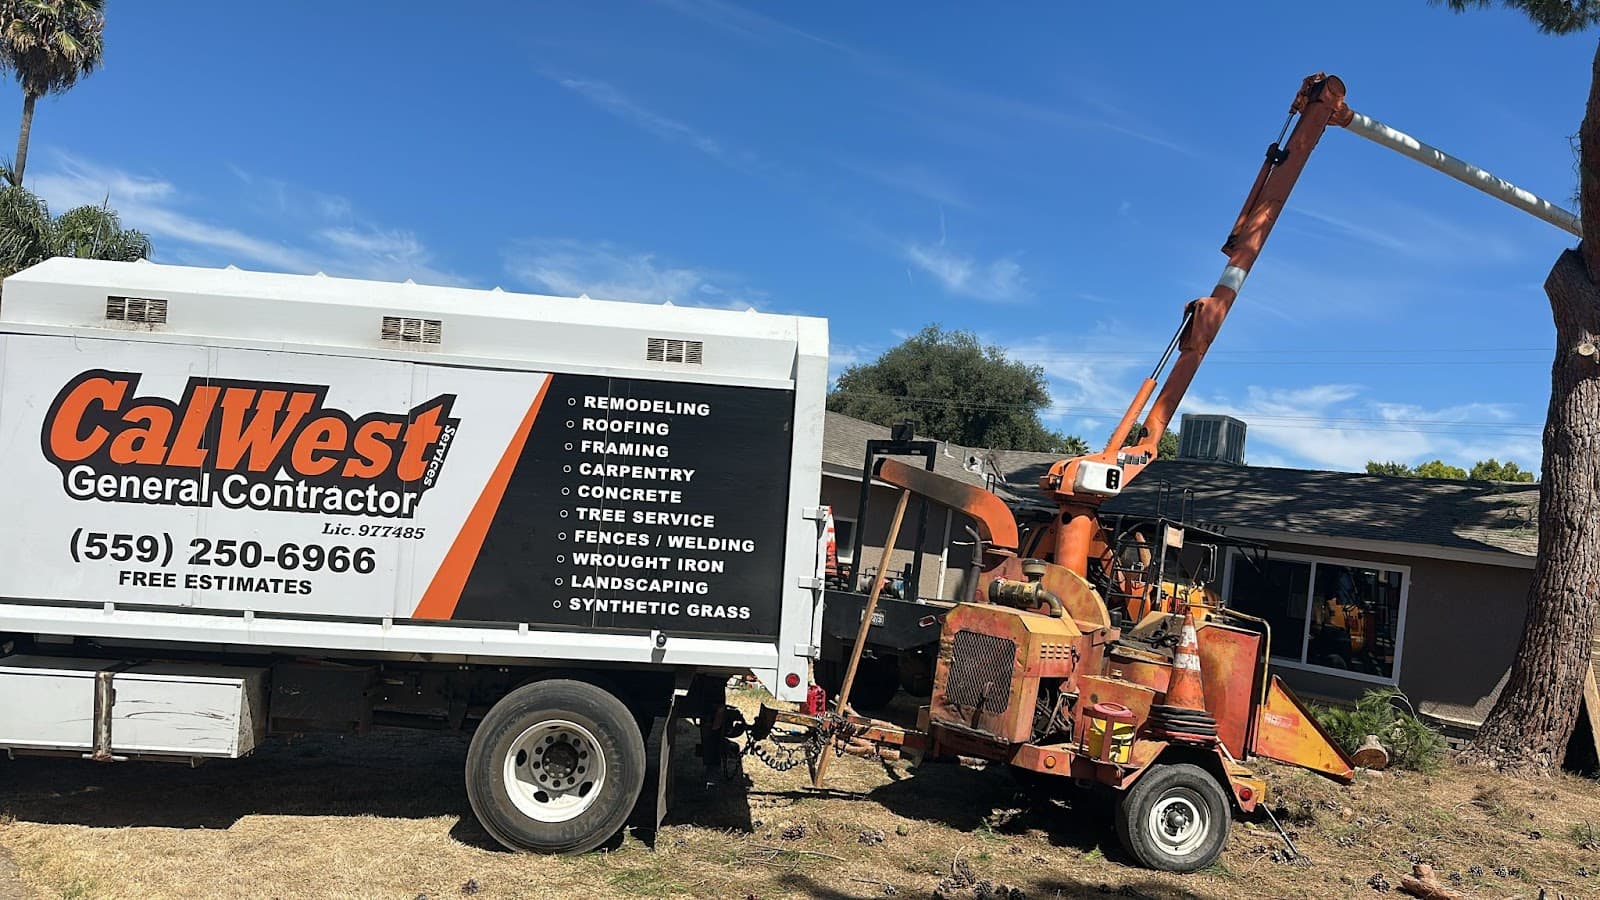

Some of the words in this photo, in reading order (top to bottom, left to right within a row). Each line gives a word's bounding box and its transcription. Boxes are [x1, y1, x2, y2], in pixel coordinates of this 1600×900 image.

[584, 396, 710, 417] REMODELING
[49, 377, 446, 482] CalWest
[582, 418, 669, 436] ROOFING
[424, 425, 456, 486] Services
[581, 440, 669, 458] FRAMING
[579, 462, 695, 482] CARPENTRY
[67, 465, 210, 503] General
[222, 473, 417, 515] Contractor
[577, 485, 682, 503] CONCRETE
[575, 507, 626, 523] TREE
[632, 511, 715, 528] SERVICE
[70, 527, 174, 568] (559)
[188, 538, 376, 575] 250-6966
[574, 530, 650, 546] FENCES
[667, 535, 755, 552] WELDING
[572, 552, 671, 570] WROUGHT
[677, 558, 724, 573] IRON
[118, 567, 177, 588] FREE
[184, 574, 312, 595] ESTIMATES
[571, 574, 708, 595] LANDSCAPING
[569, 597, 680, 616] SYNTHETIC
[686, 603, 750, 620] GRASS
